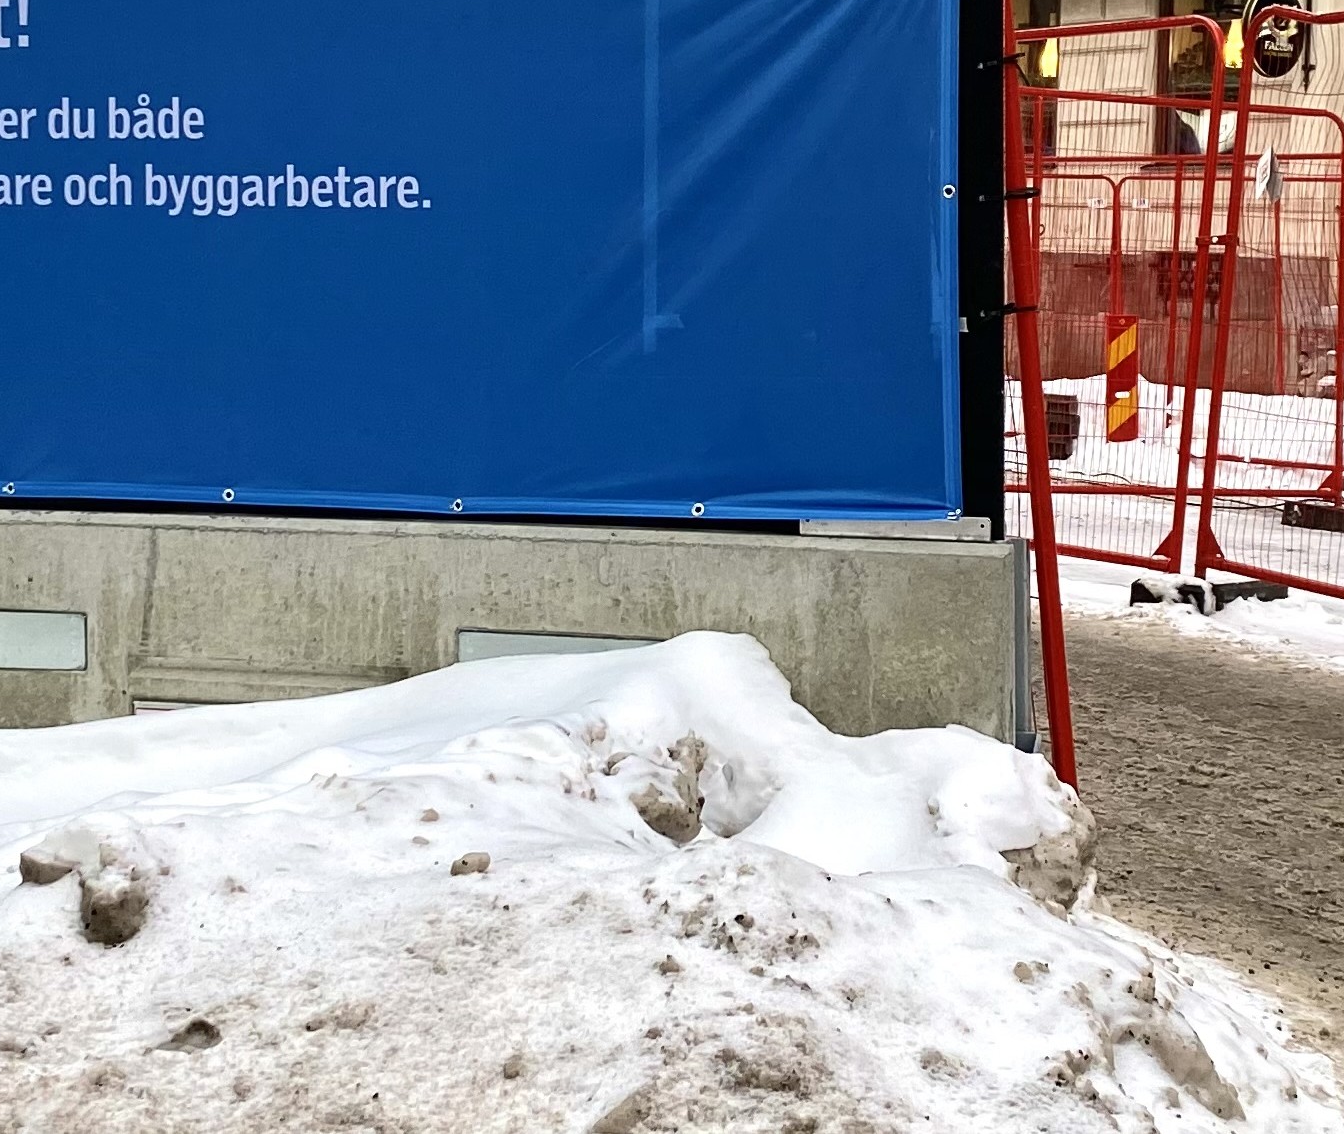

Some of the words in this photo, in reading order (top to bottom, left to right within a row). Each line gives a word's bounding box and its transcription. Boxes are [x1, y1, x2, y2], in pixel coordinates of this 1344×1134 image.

[47, 96, 96, 140] du
[107, 94, 205, 140] både
[63, 163, 133, 207] och
[145, 163, 432, 217] byggarbetare.
